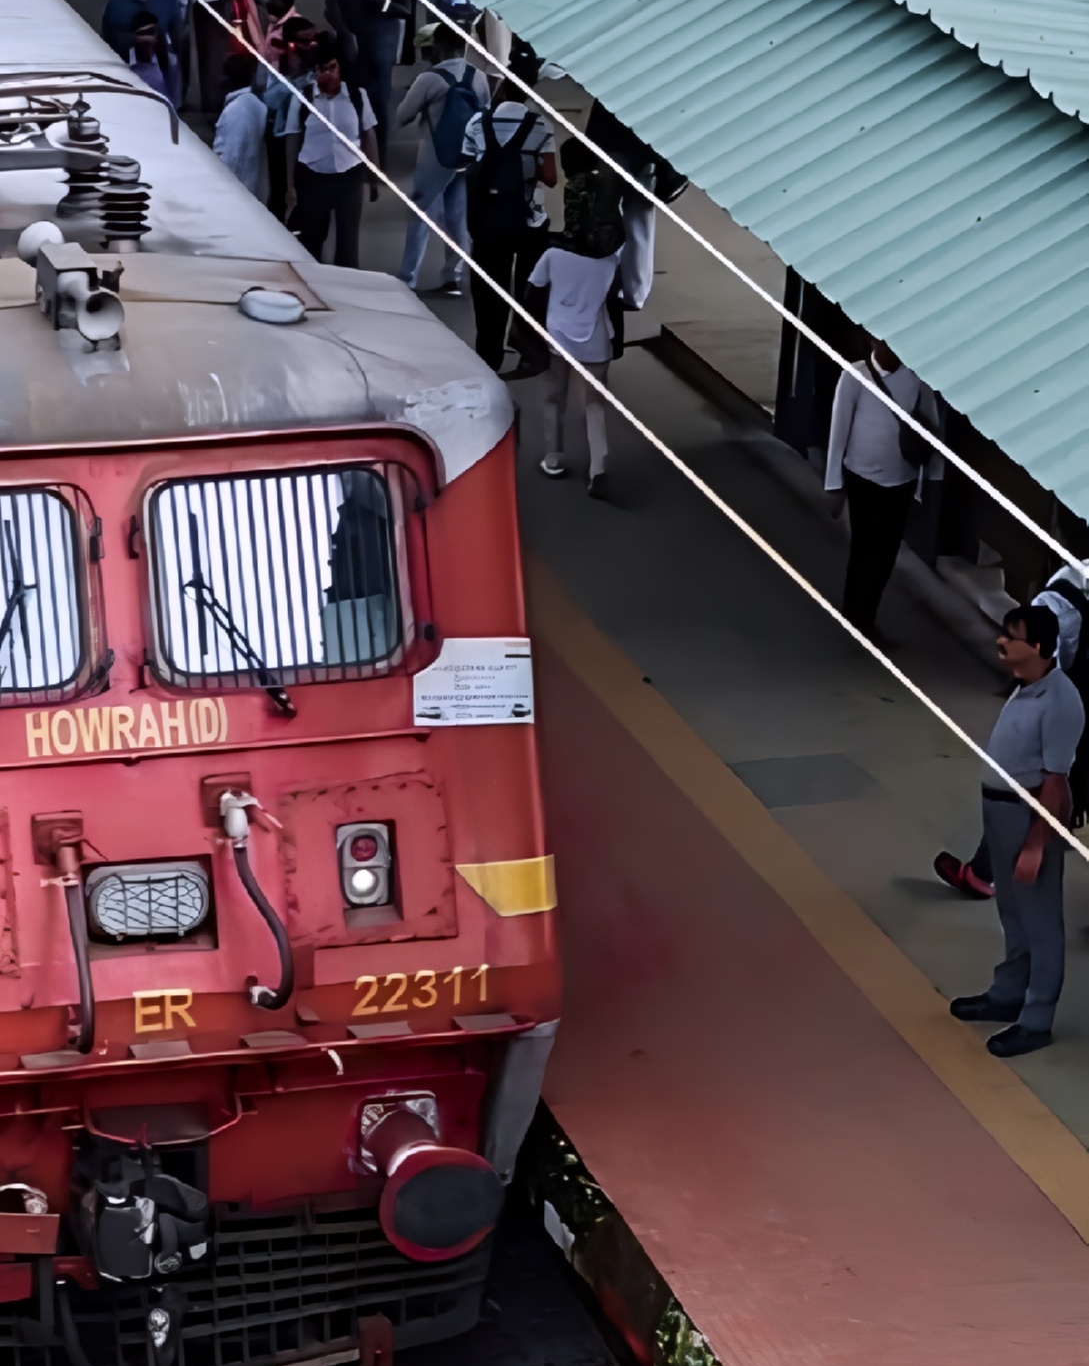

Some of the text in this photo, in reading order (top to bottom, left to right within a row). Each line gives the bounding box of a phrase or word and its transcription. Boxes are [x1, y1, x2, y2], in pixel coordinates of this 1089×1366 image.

[25, 697, 228, 758] HOWRAH(D)
[132, 988, 197, 1034] ER
[351, 963, 490, 1016] 22311
